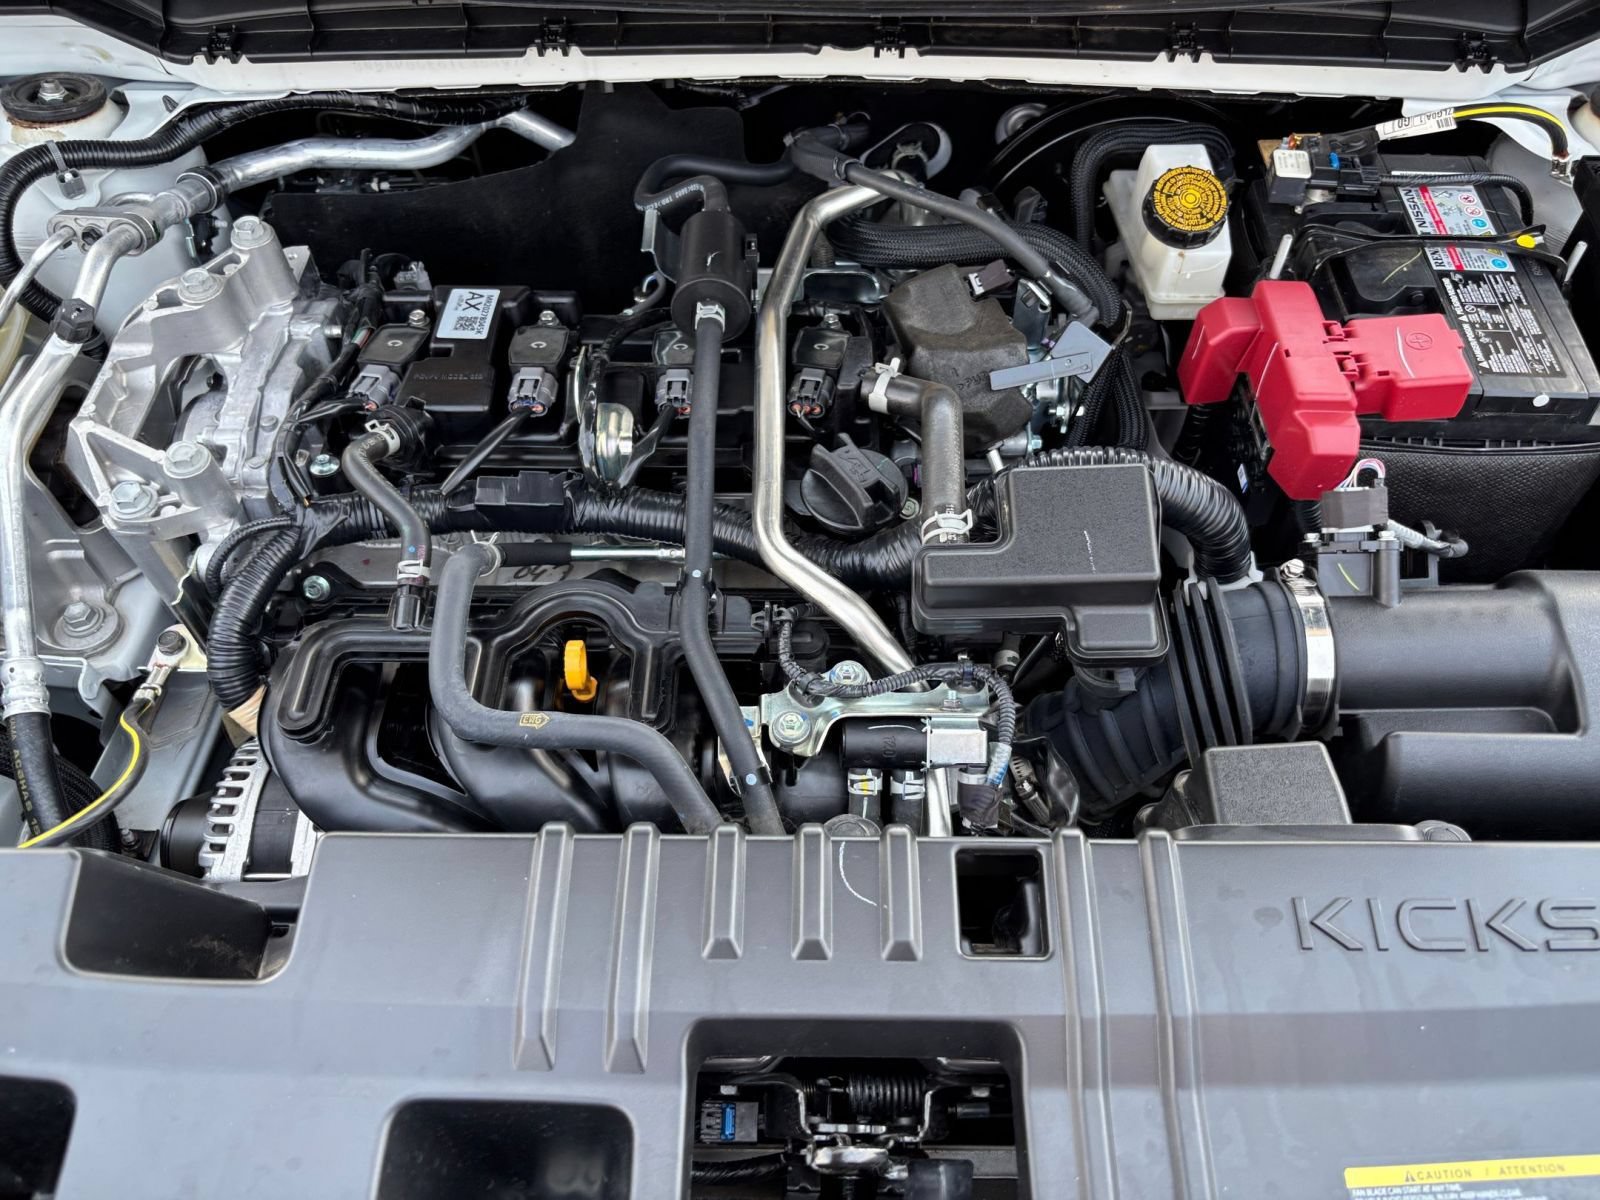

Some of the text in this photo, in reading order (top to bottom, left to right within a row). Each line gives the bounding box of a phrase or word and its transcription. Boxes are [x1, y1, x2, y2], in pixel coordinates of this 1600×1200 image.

[1406, 188, 1427, 228] NISSAN
[462, 291, 485, 311] AX
[1291, 896, 1600, 952] KICKS
[1416, 1168, 1473, 1181] CAUTION
[1499, 1164, 1566, 1176] ATTENTION
